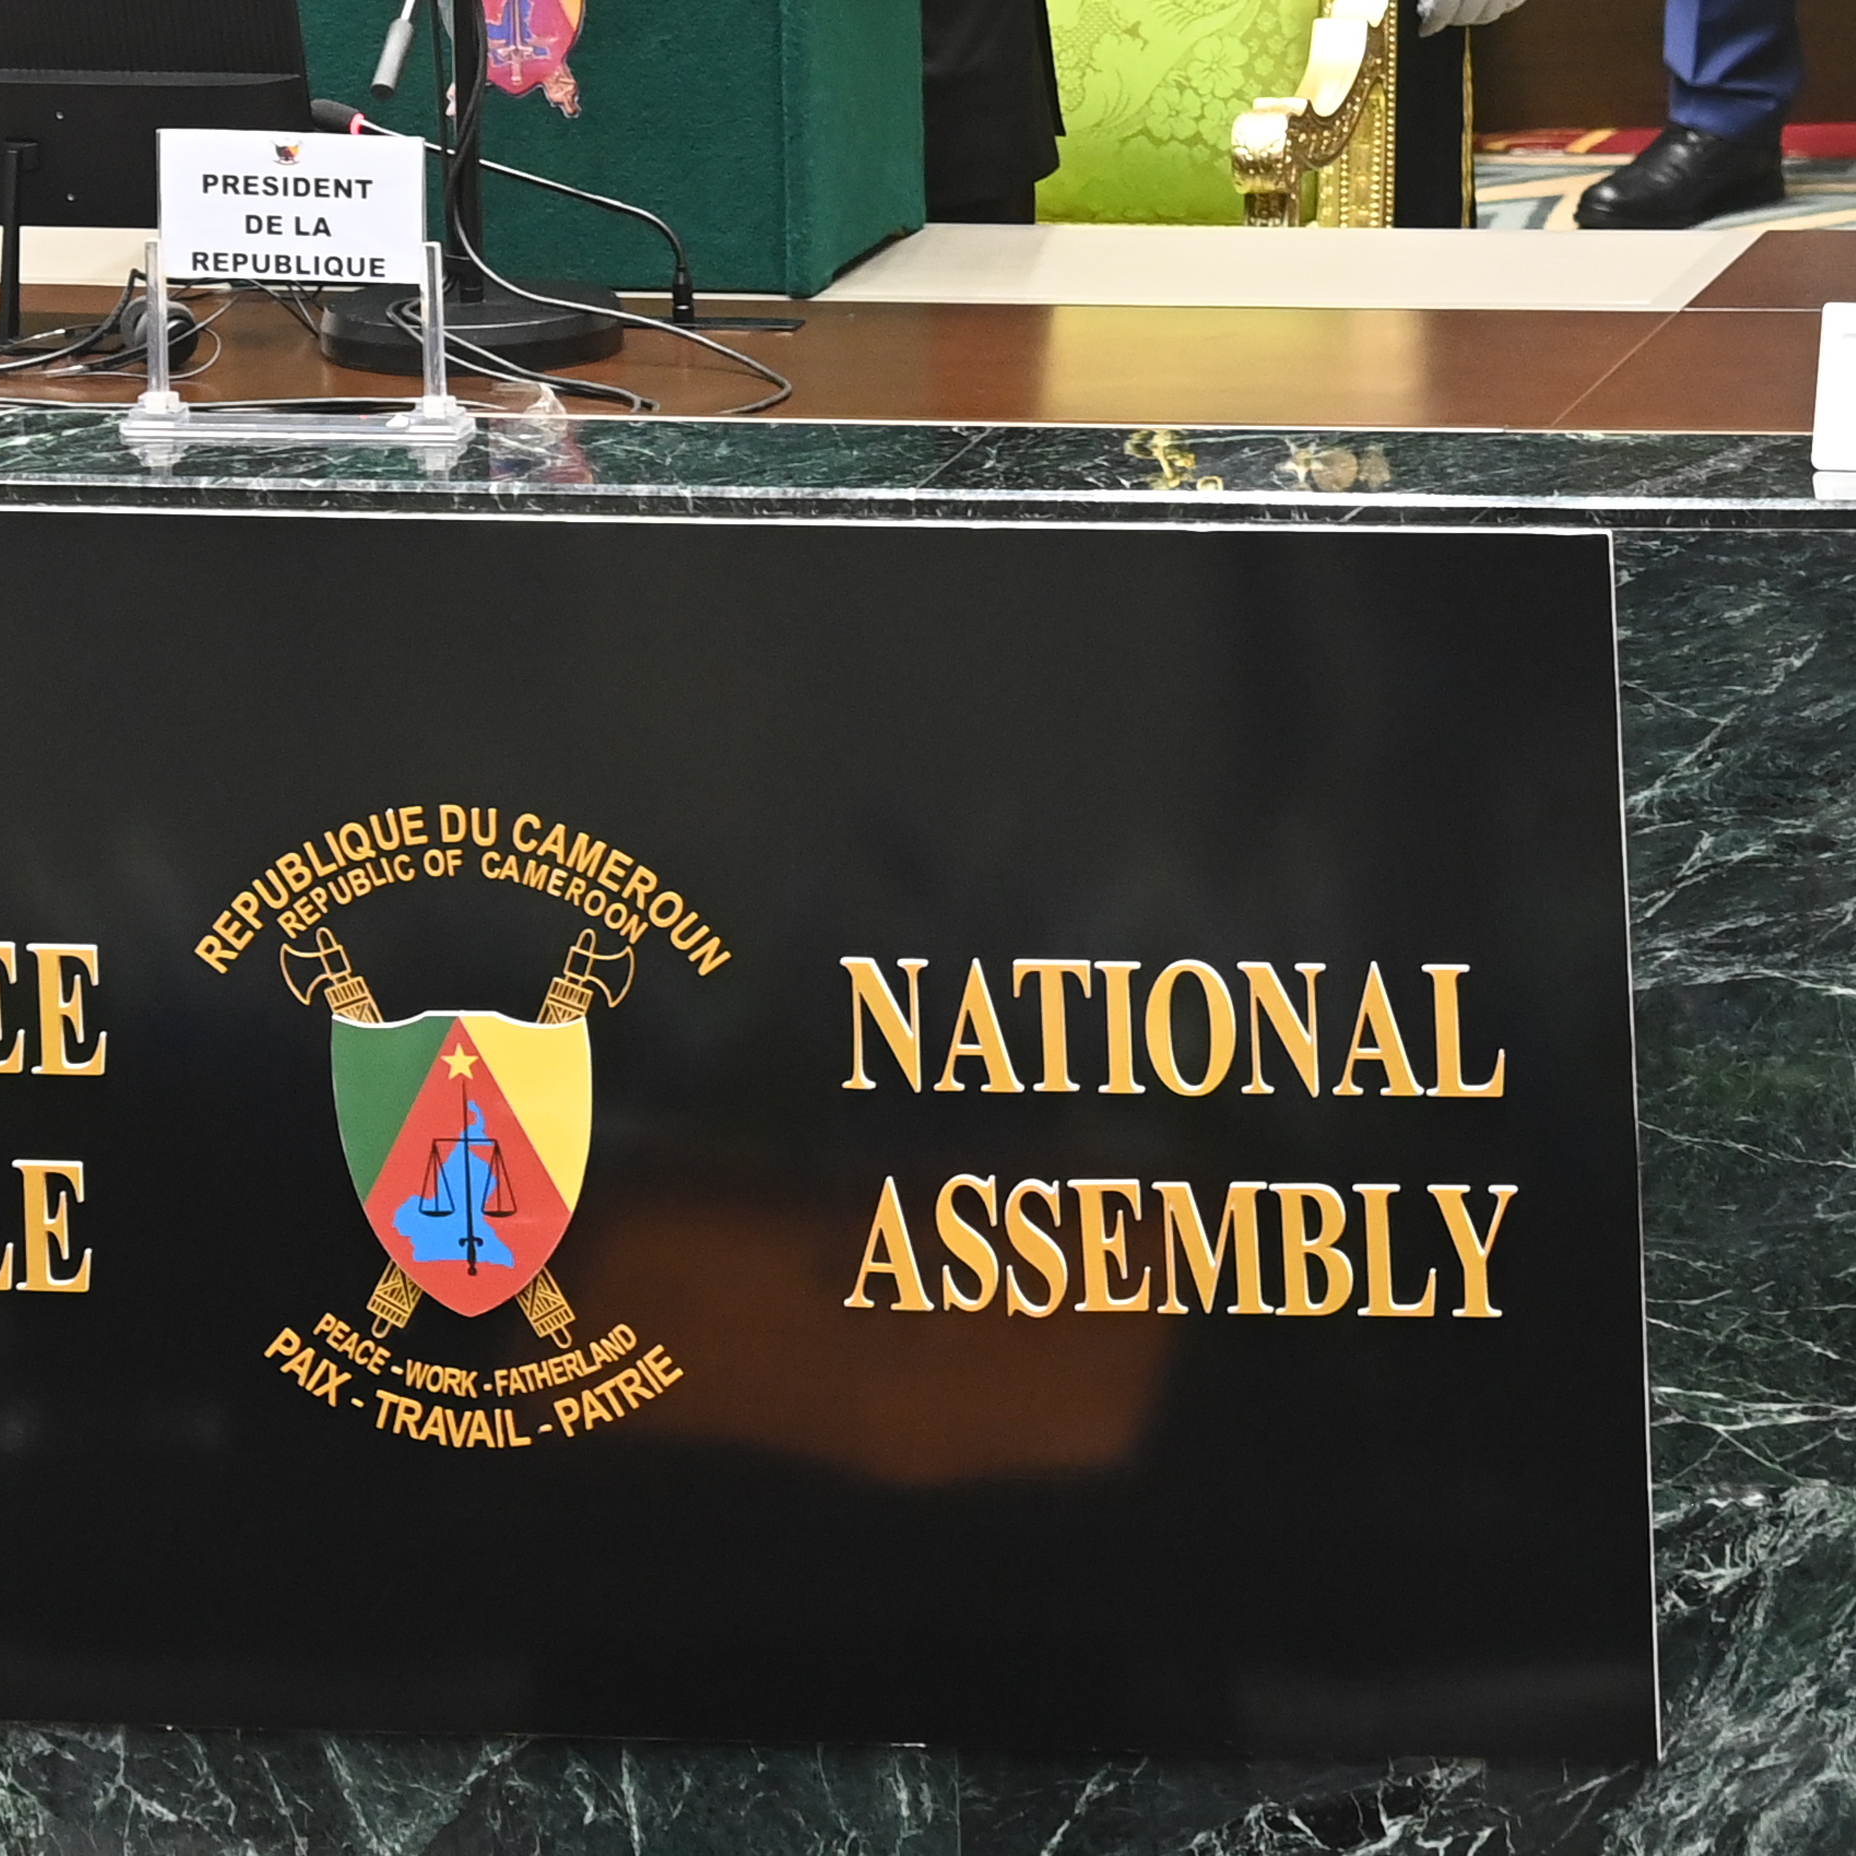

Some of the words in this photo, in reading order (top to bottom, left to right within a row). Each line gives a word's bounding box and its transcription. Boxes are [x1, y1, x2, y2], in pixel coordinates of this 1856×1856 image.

[201, 174, 374, 200] PRESIDENT
[244, 214, 284, 236] DE
[293, 216, 332, 238] LA
[191, 251, 386, 279] REPUBLIQUE
[194, 805, 428, 974] REPUBLIQUE
[439, 804, 498, 846] DU
[512, 813, 732, 977] CAMEROUN
[276, 854, 416, 939] REPUBLIC
[423, 849, 463, 877] OF
[481, 851, 649, 944] CAMEROON
[838, 954, 1507, 1100] NATIONAL
[842, 1172, 1519, 1320] ASSEMBLY
[264, 1327, 352, 1407] PAIX
[375, 1389, 532, 1449] TRAVAIL
[553, 1344, 685, 1438] PATRIE
[312, 1312, 391, 1375] PEACE
[404, 1359, 478, 1398] WORK
[494, 1323, 638, 1397] FATHERLAND
